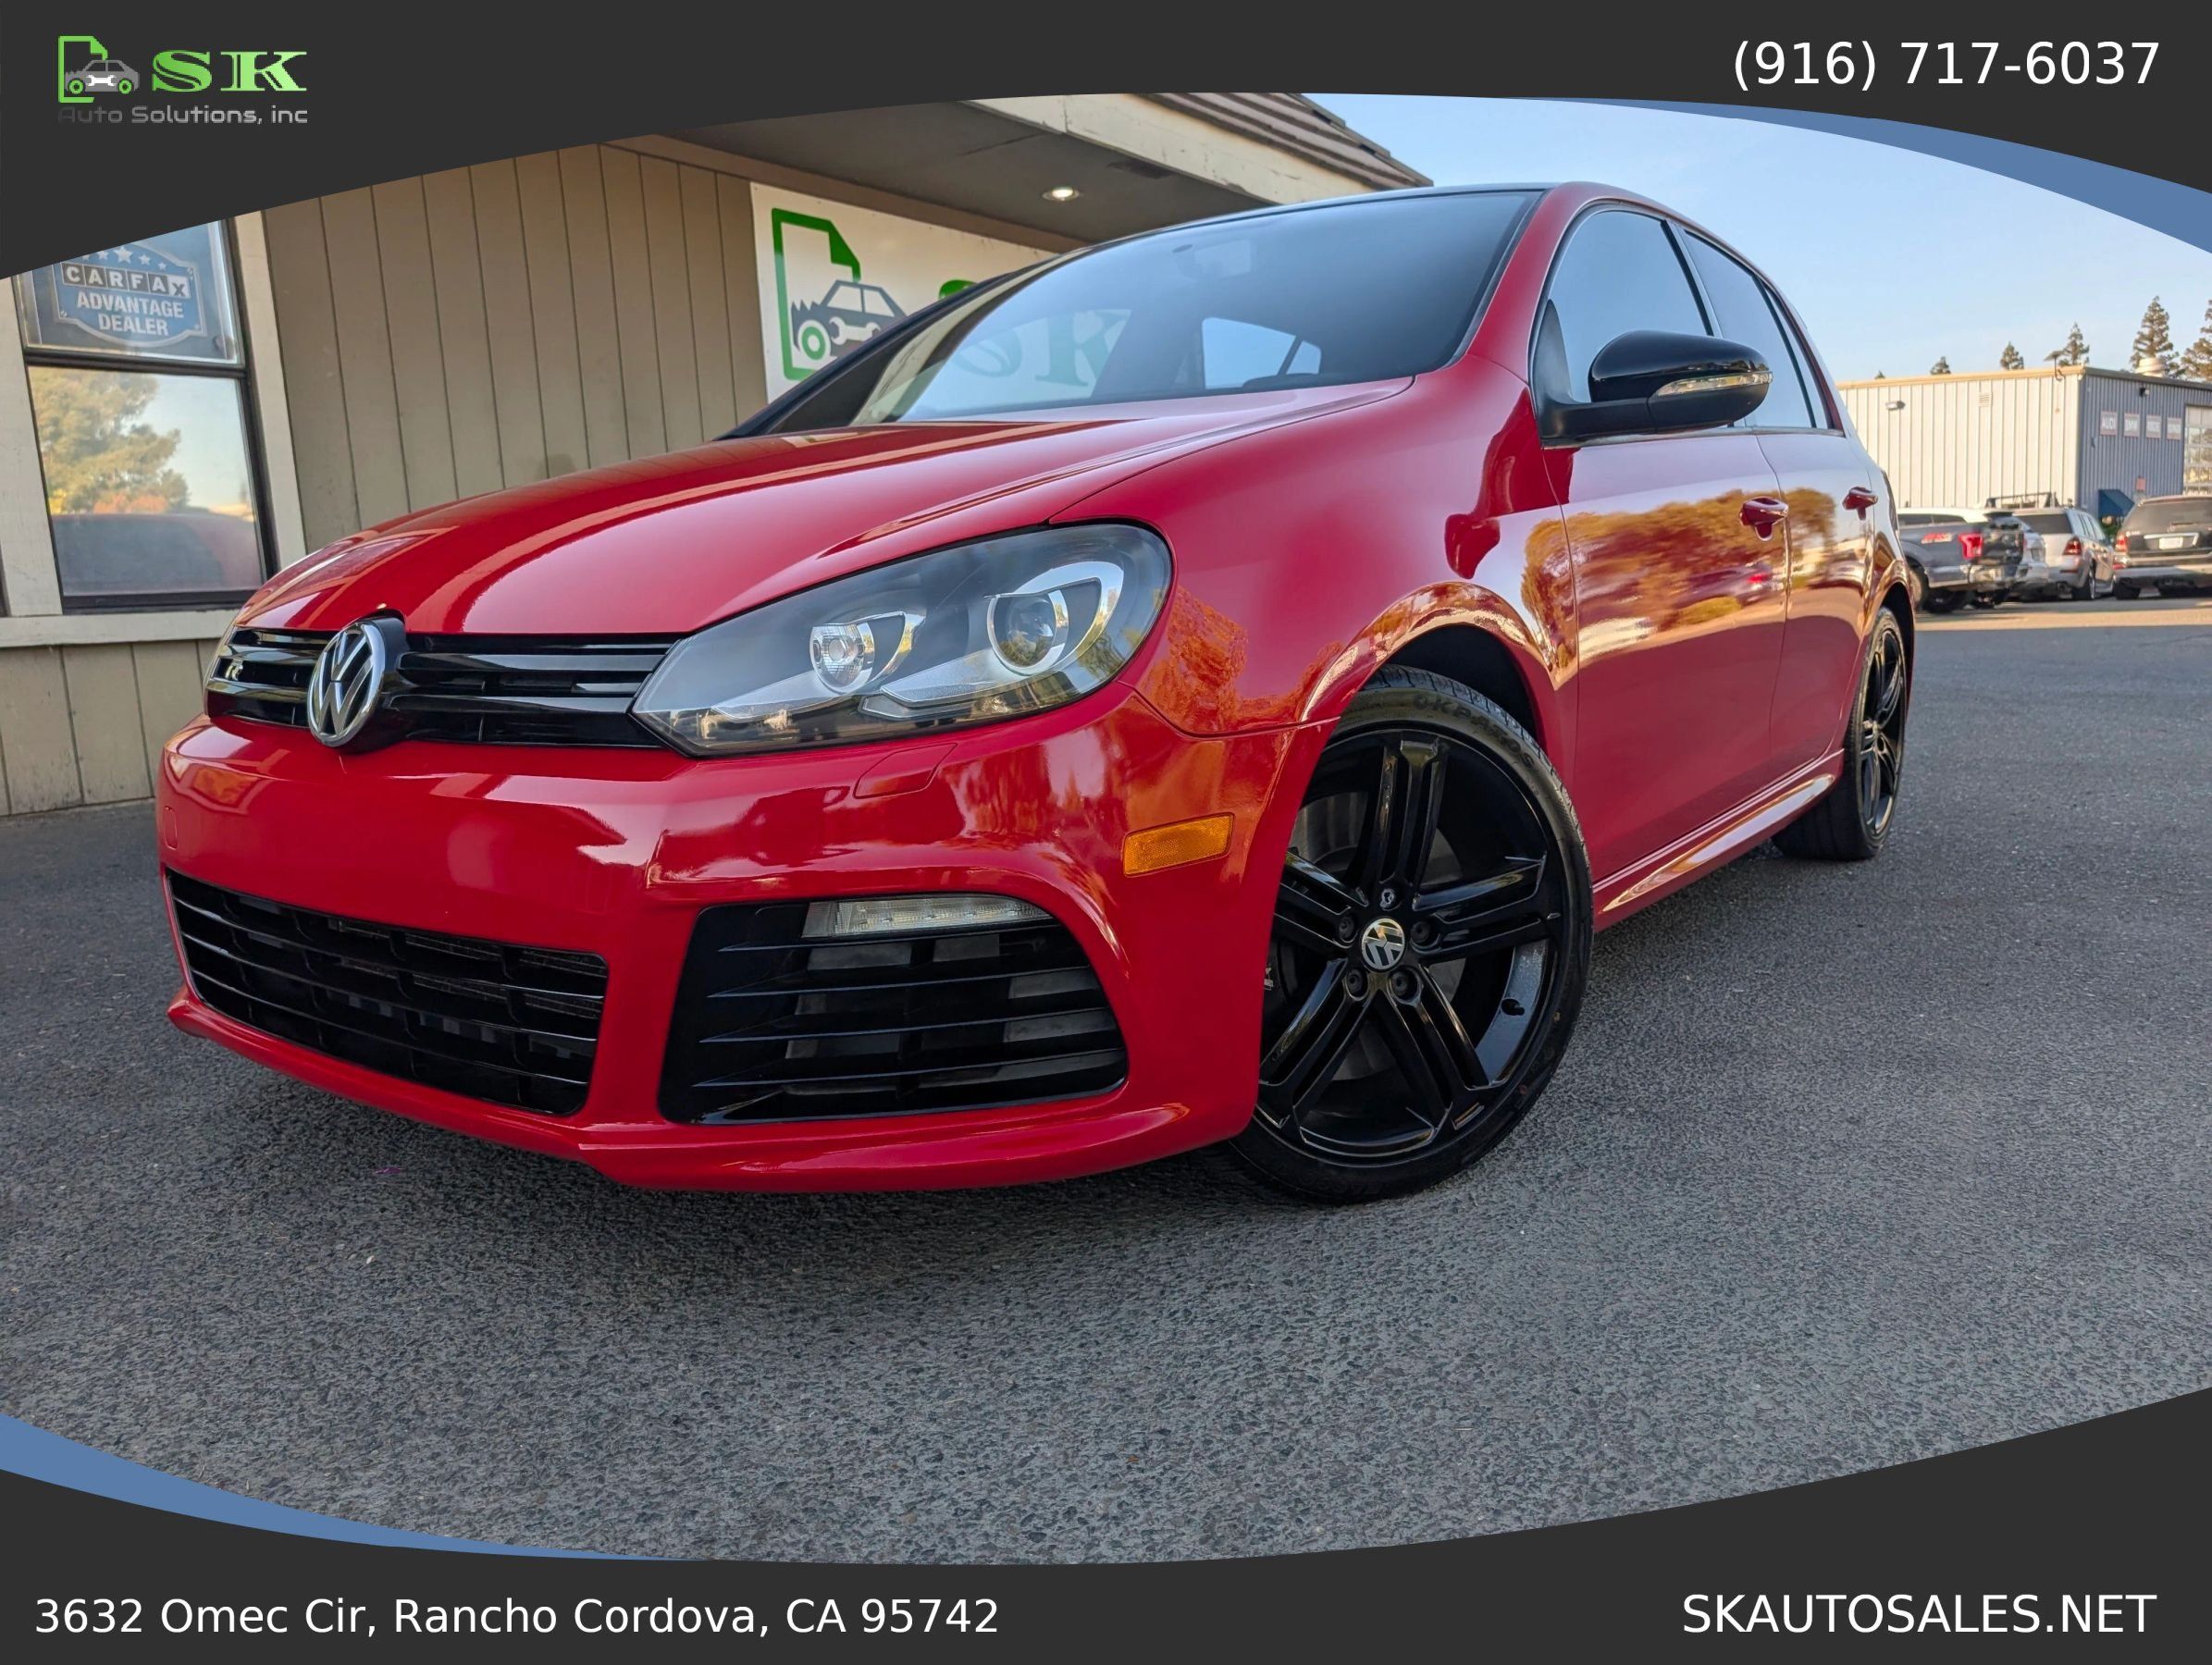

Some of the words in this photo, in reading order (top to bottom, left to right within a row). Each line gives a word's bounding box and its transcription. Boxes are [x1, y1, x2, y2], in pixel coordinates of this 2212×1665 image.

[64, 265, 187, 296] CARFAX
[77, 291, 184, 318] ADVANTAGE
[98, 314, 169, 337] DEALER
